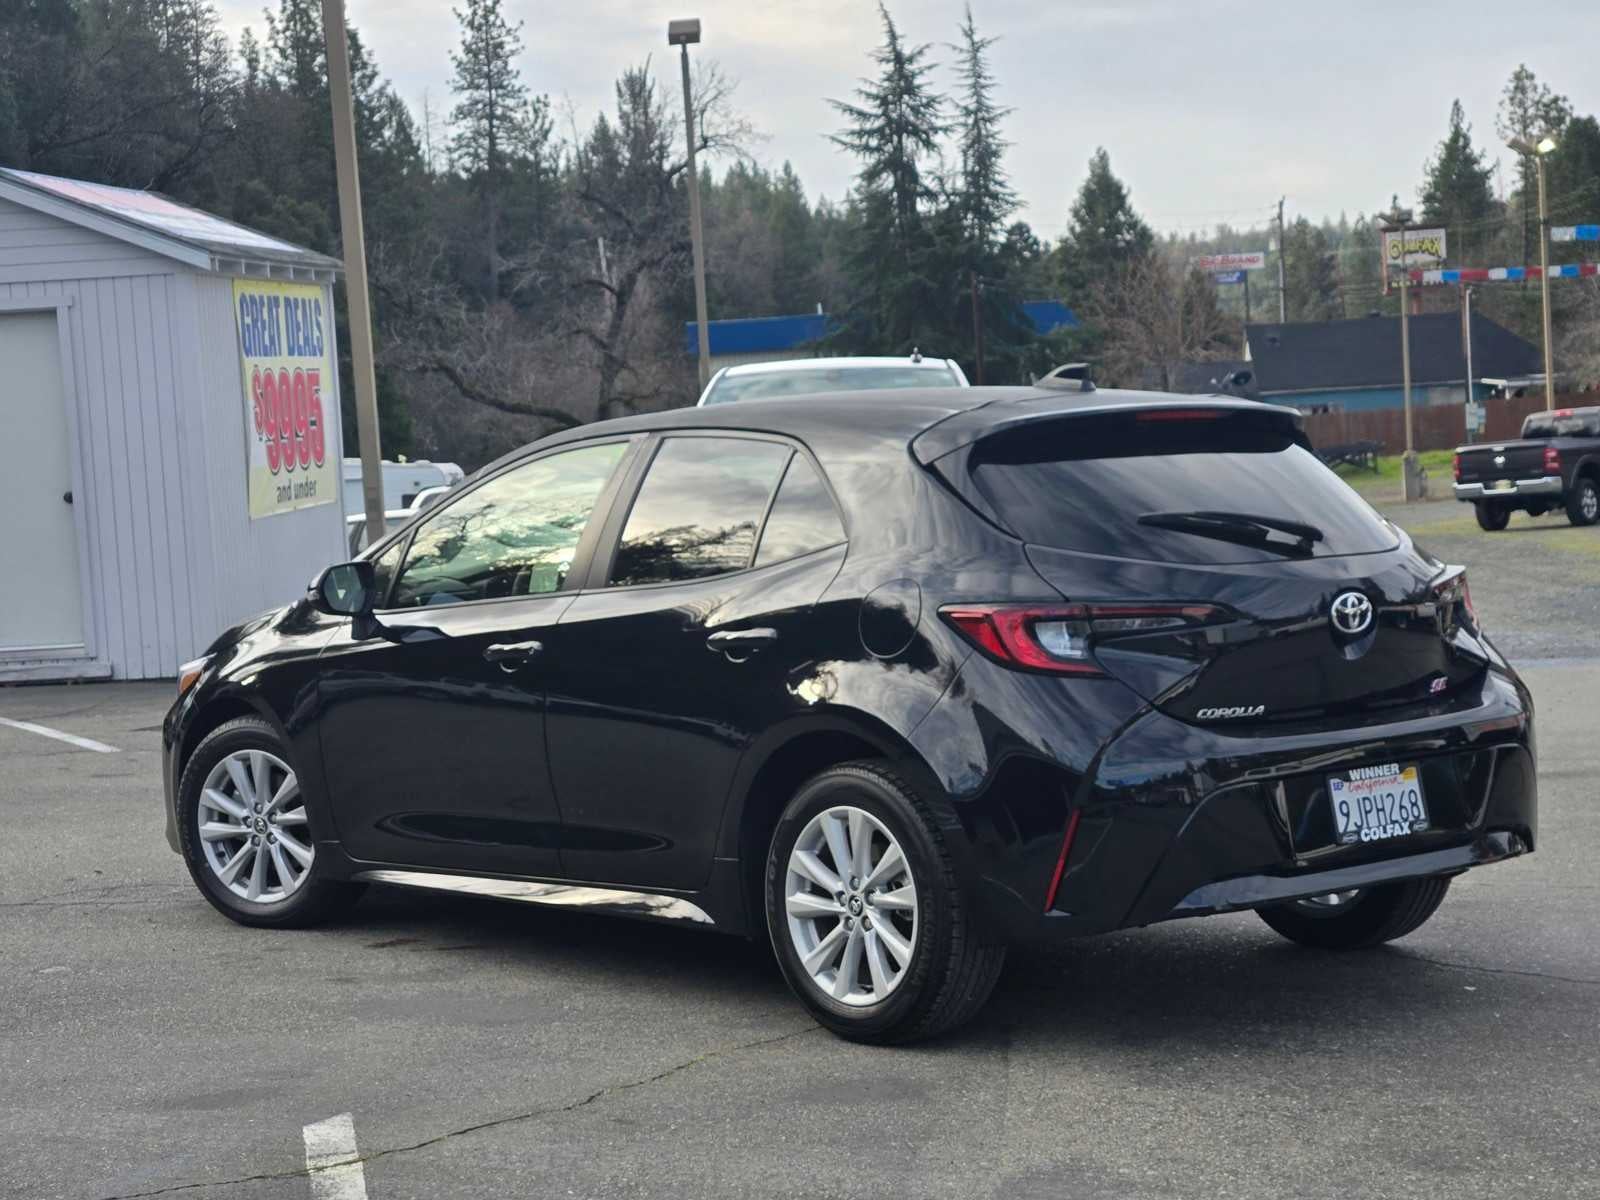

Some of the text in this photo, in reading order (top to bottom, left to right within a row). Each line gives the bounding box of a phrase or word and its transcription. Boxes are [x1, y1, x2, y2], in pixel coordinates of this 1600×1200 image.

[239, 291, 324, 358] GREAT DEALS
[251, 364, 326, 476] $9995
[277, 475, 317, 504] and under
[1196, 704, 1265, 719] COROLLA
[1349, 763, 1400, 780] WINNER
[1338, 788, 1421, 833] 9JPH268
[1360, 821, 1411, 842] COLFAX
